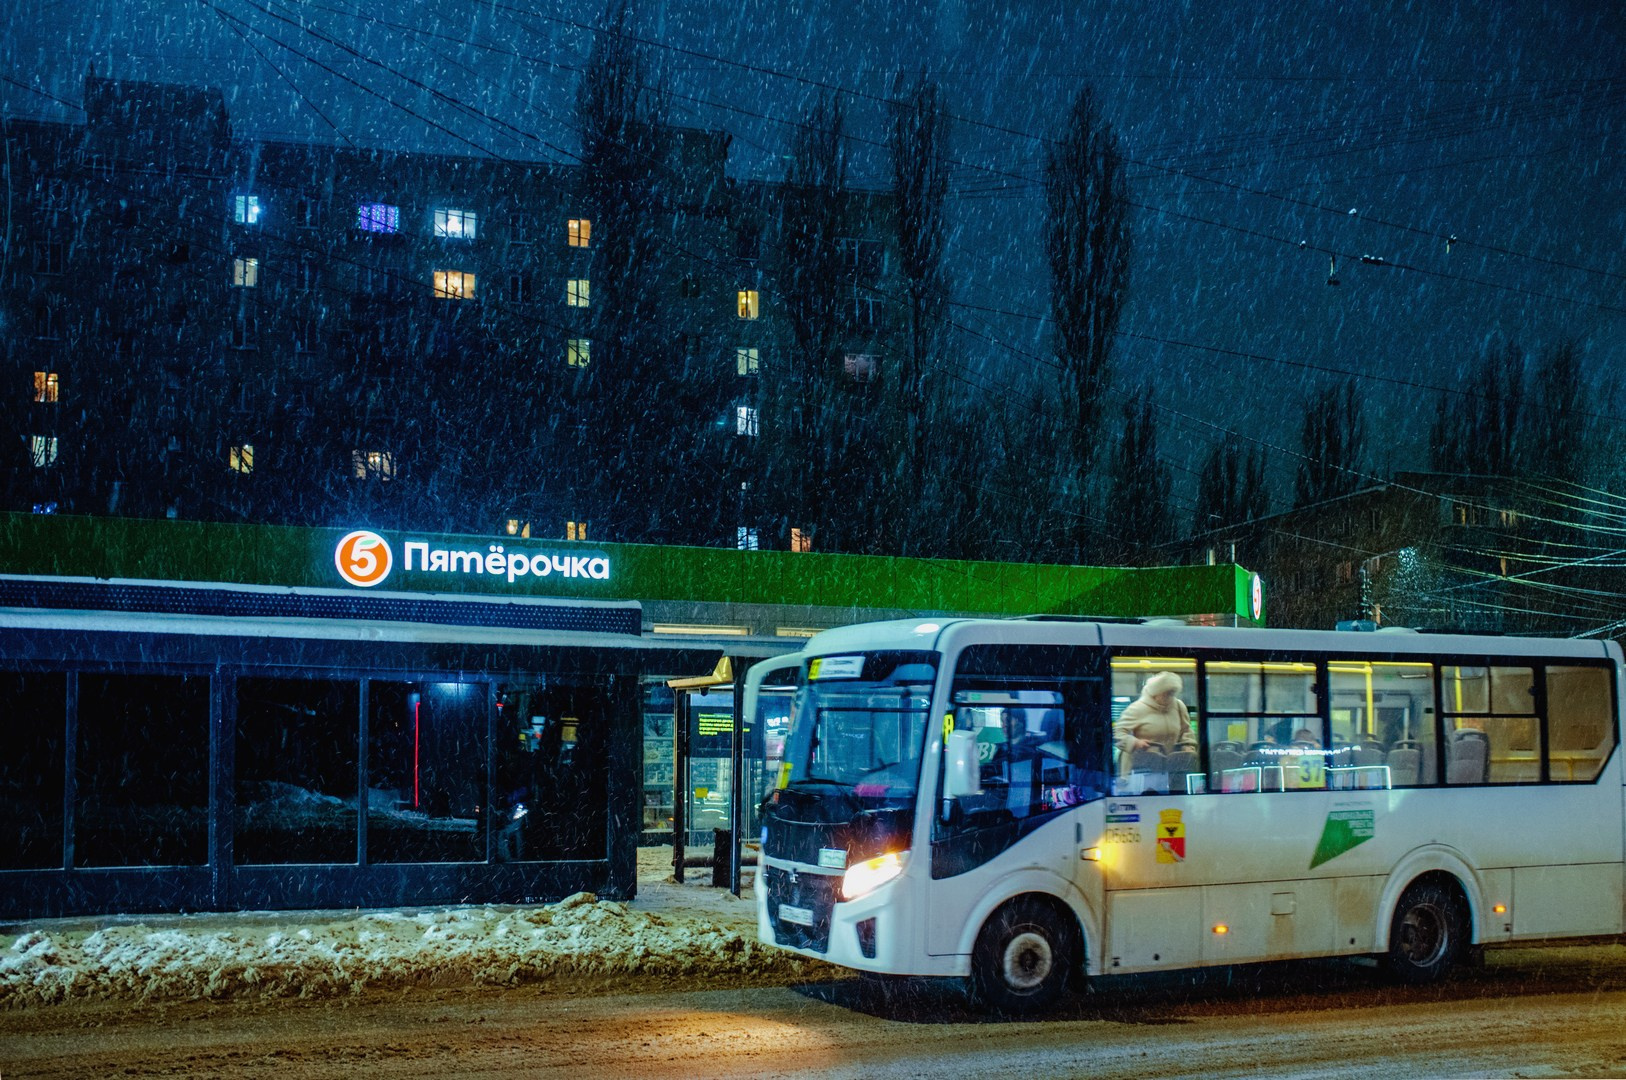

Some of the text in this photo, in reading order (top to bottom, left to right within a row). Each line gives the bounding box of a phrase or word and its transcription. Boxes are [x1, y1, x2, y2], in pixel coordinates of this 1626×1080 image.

[350, 535, 610, 583] 5 Пятёрочка
[1300, 759, 1322, 782] 37
